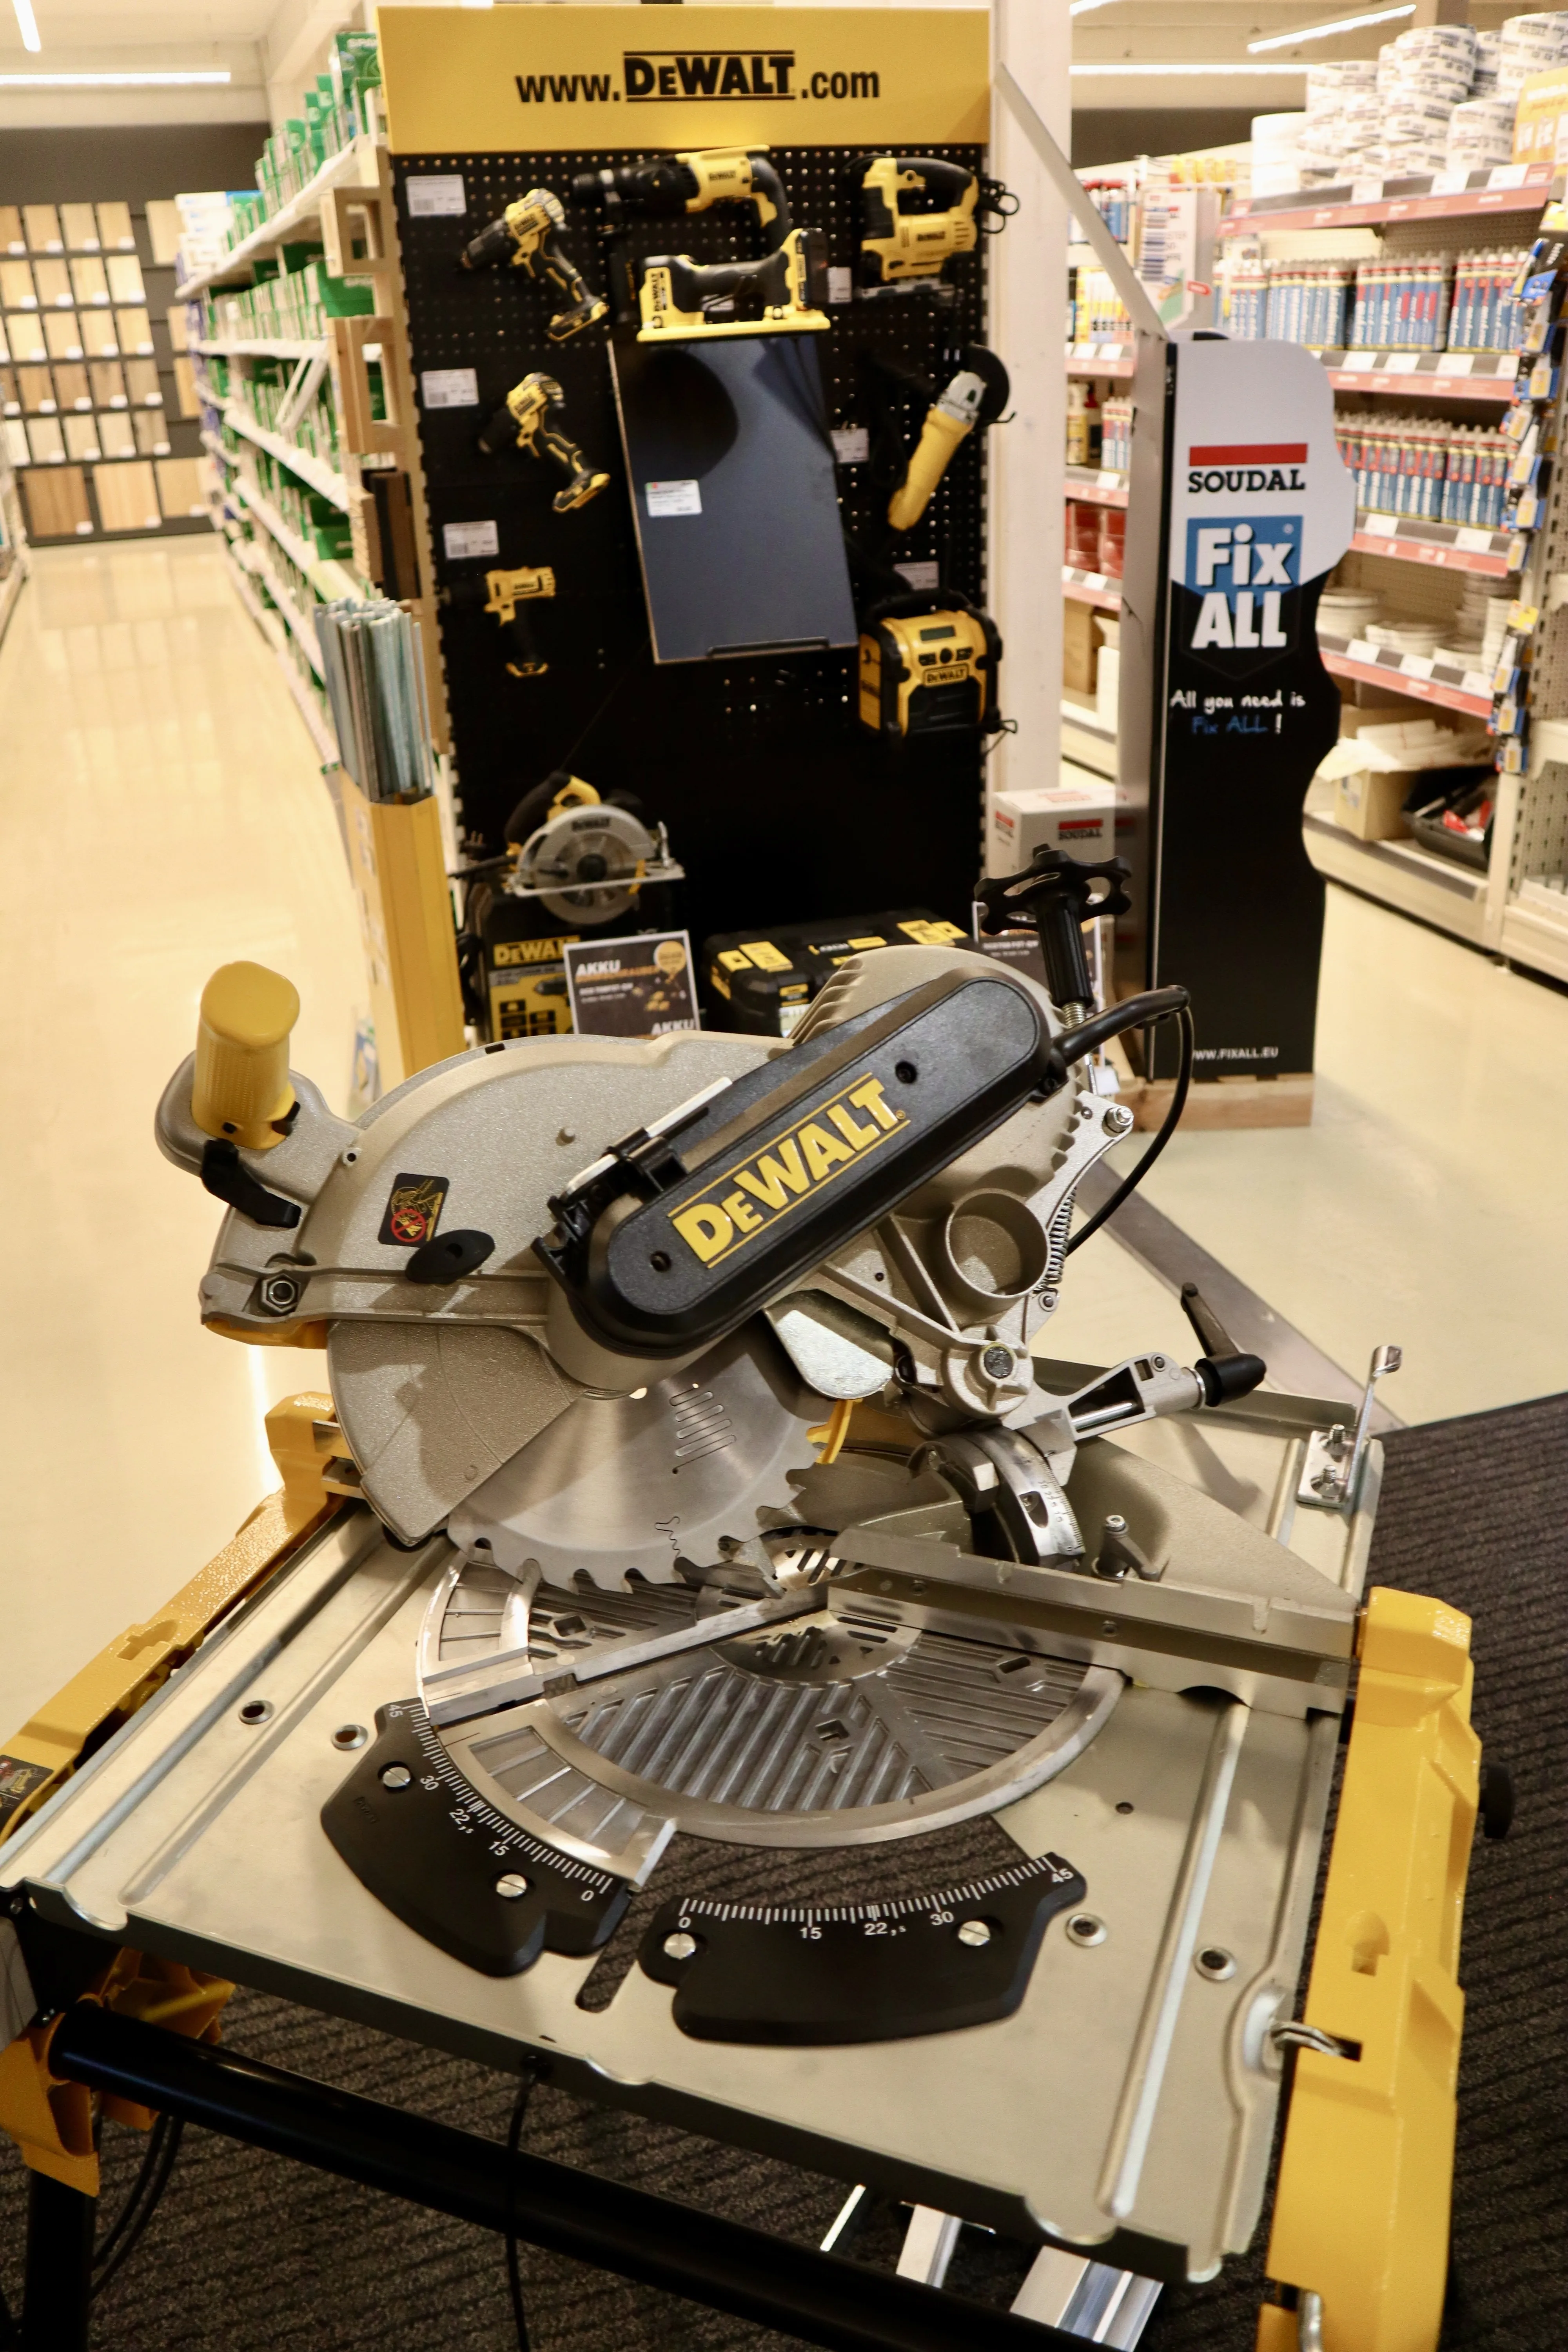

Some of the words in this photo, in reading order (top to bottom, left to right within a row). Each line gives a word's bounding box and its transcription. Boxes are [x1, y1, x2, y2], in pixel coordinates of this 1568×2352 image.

[1188, 469, 1305, 493] SOUDAL
[1195, 524, 1294, 586] Fix
[1191, 591, 1287, 649] ALL
[1170, 689, 1196, 708] All
[1203, 697, 1234, 715] you
[1241, 689, 1283, 708] need
[1290, 691, 1306, 707] is
[1191, 716, 1218, 735] Fix
[1226, 715, 1269, 734] ALL
[575, 960, 621, 976] AKKU
[1192, 1046, 1279, 1061] WW.FIXALL.EU
[388, 1704, 404, 1718] 45
[420, 1775, 439, 1791] 30
[488, 1841, 510, 1856] 15
[581, 1890, 595, 1901] 0
[678, 1917, 691, 1928] 0
[799, 1927, 822, 1940] 15
[930, 1911, 954, 1926] 30
[1051, 1867, 1074, 1883] 45
